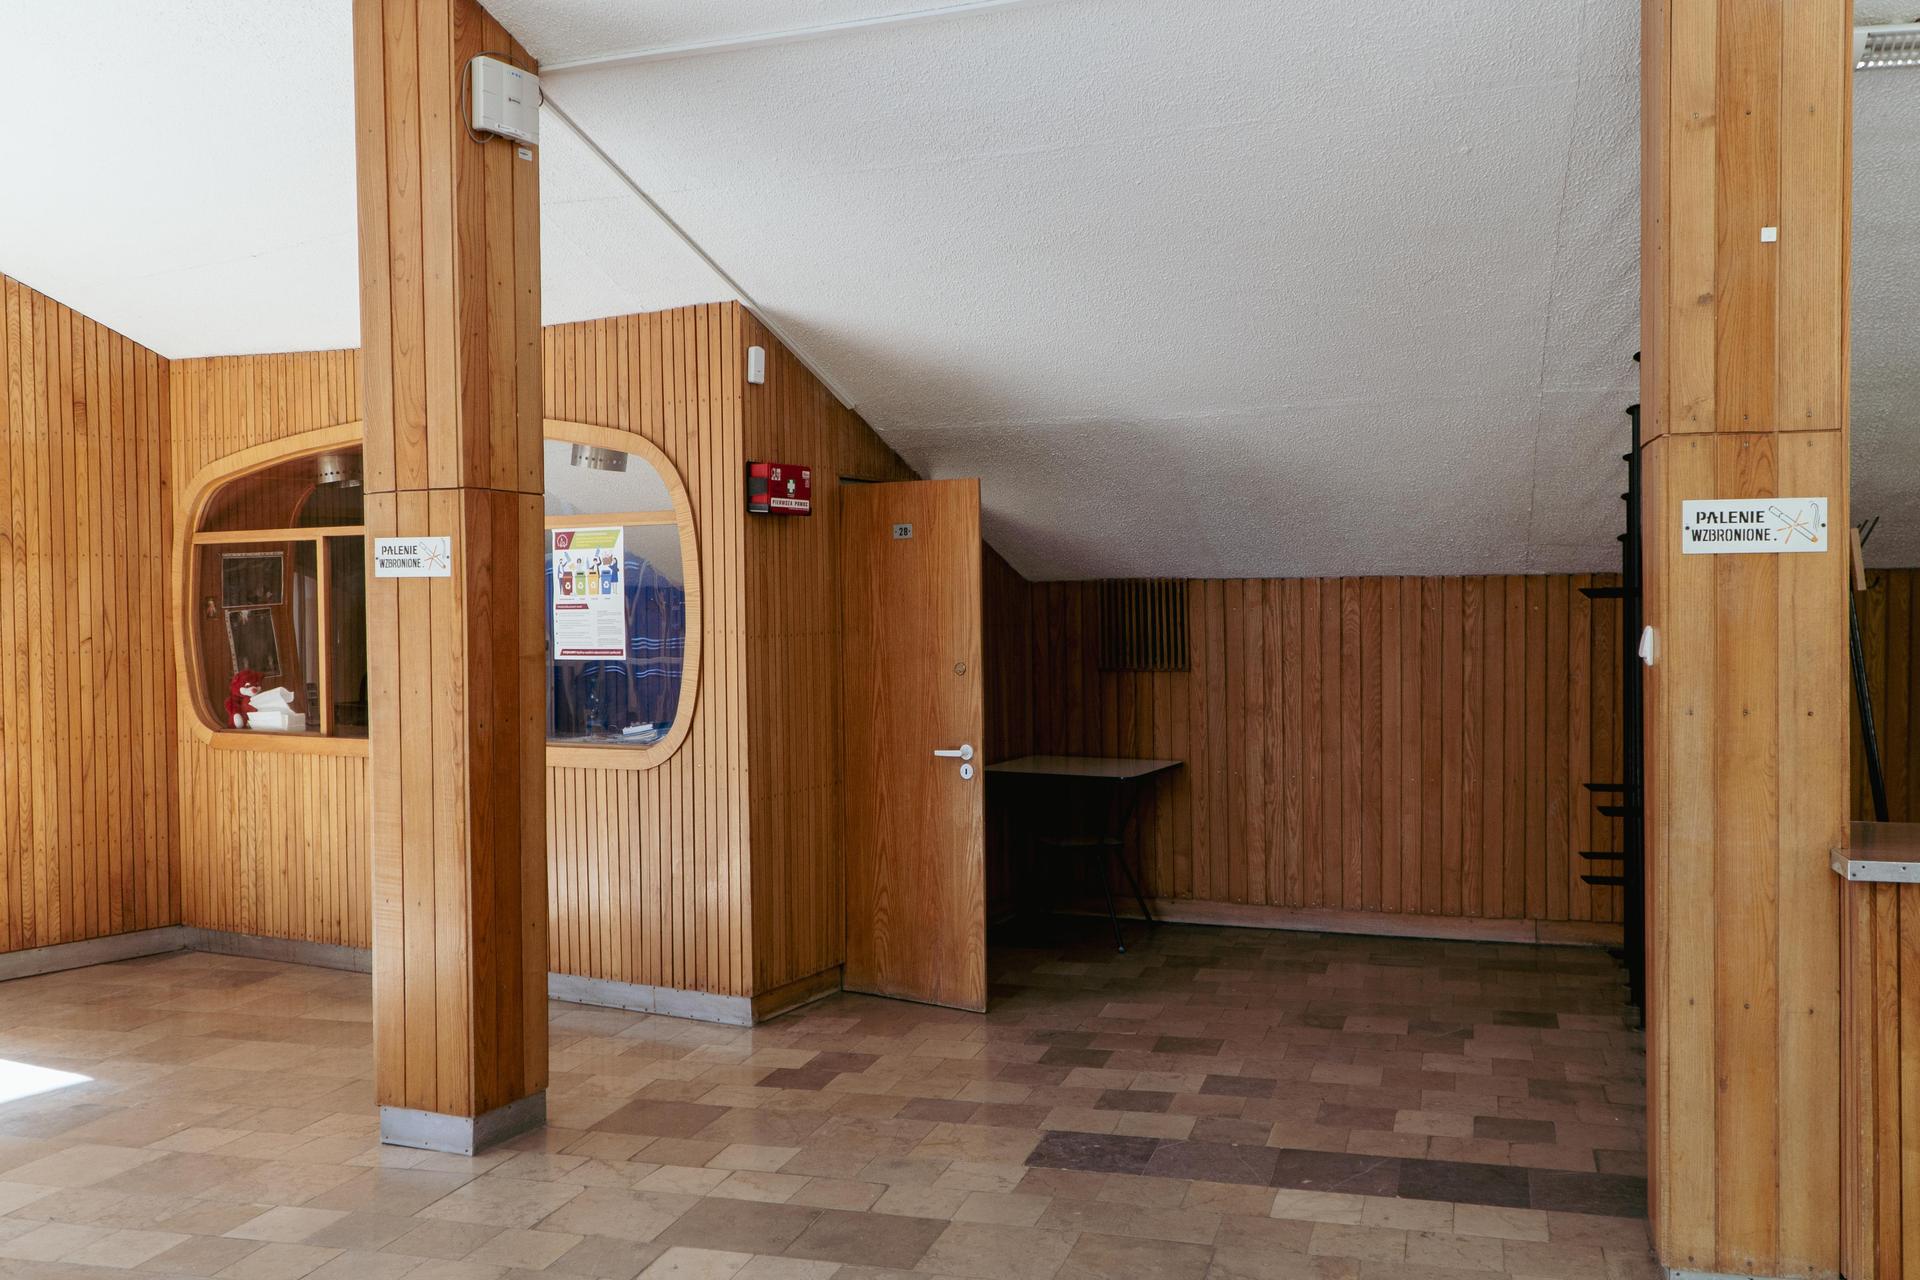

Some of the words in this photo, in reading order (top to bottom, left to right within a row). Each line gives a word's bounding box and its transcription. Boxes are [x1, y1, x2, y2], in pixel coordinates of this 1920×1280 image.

[1696, 510, 1765, 524] PALENIE
[898, 527, 909, 536] 28
[1691, 528, 1778, 542] WZBRONIONE.
[381, 545, 418, 555] PALENIE
